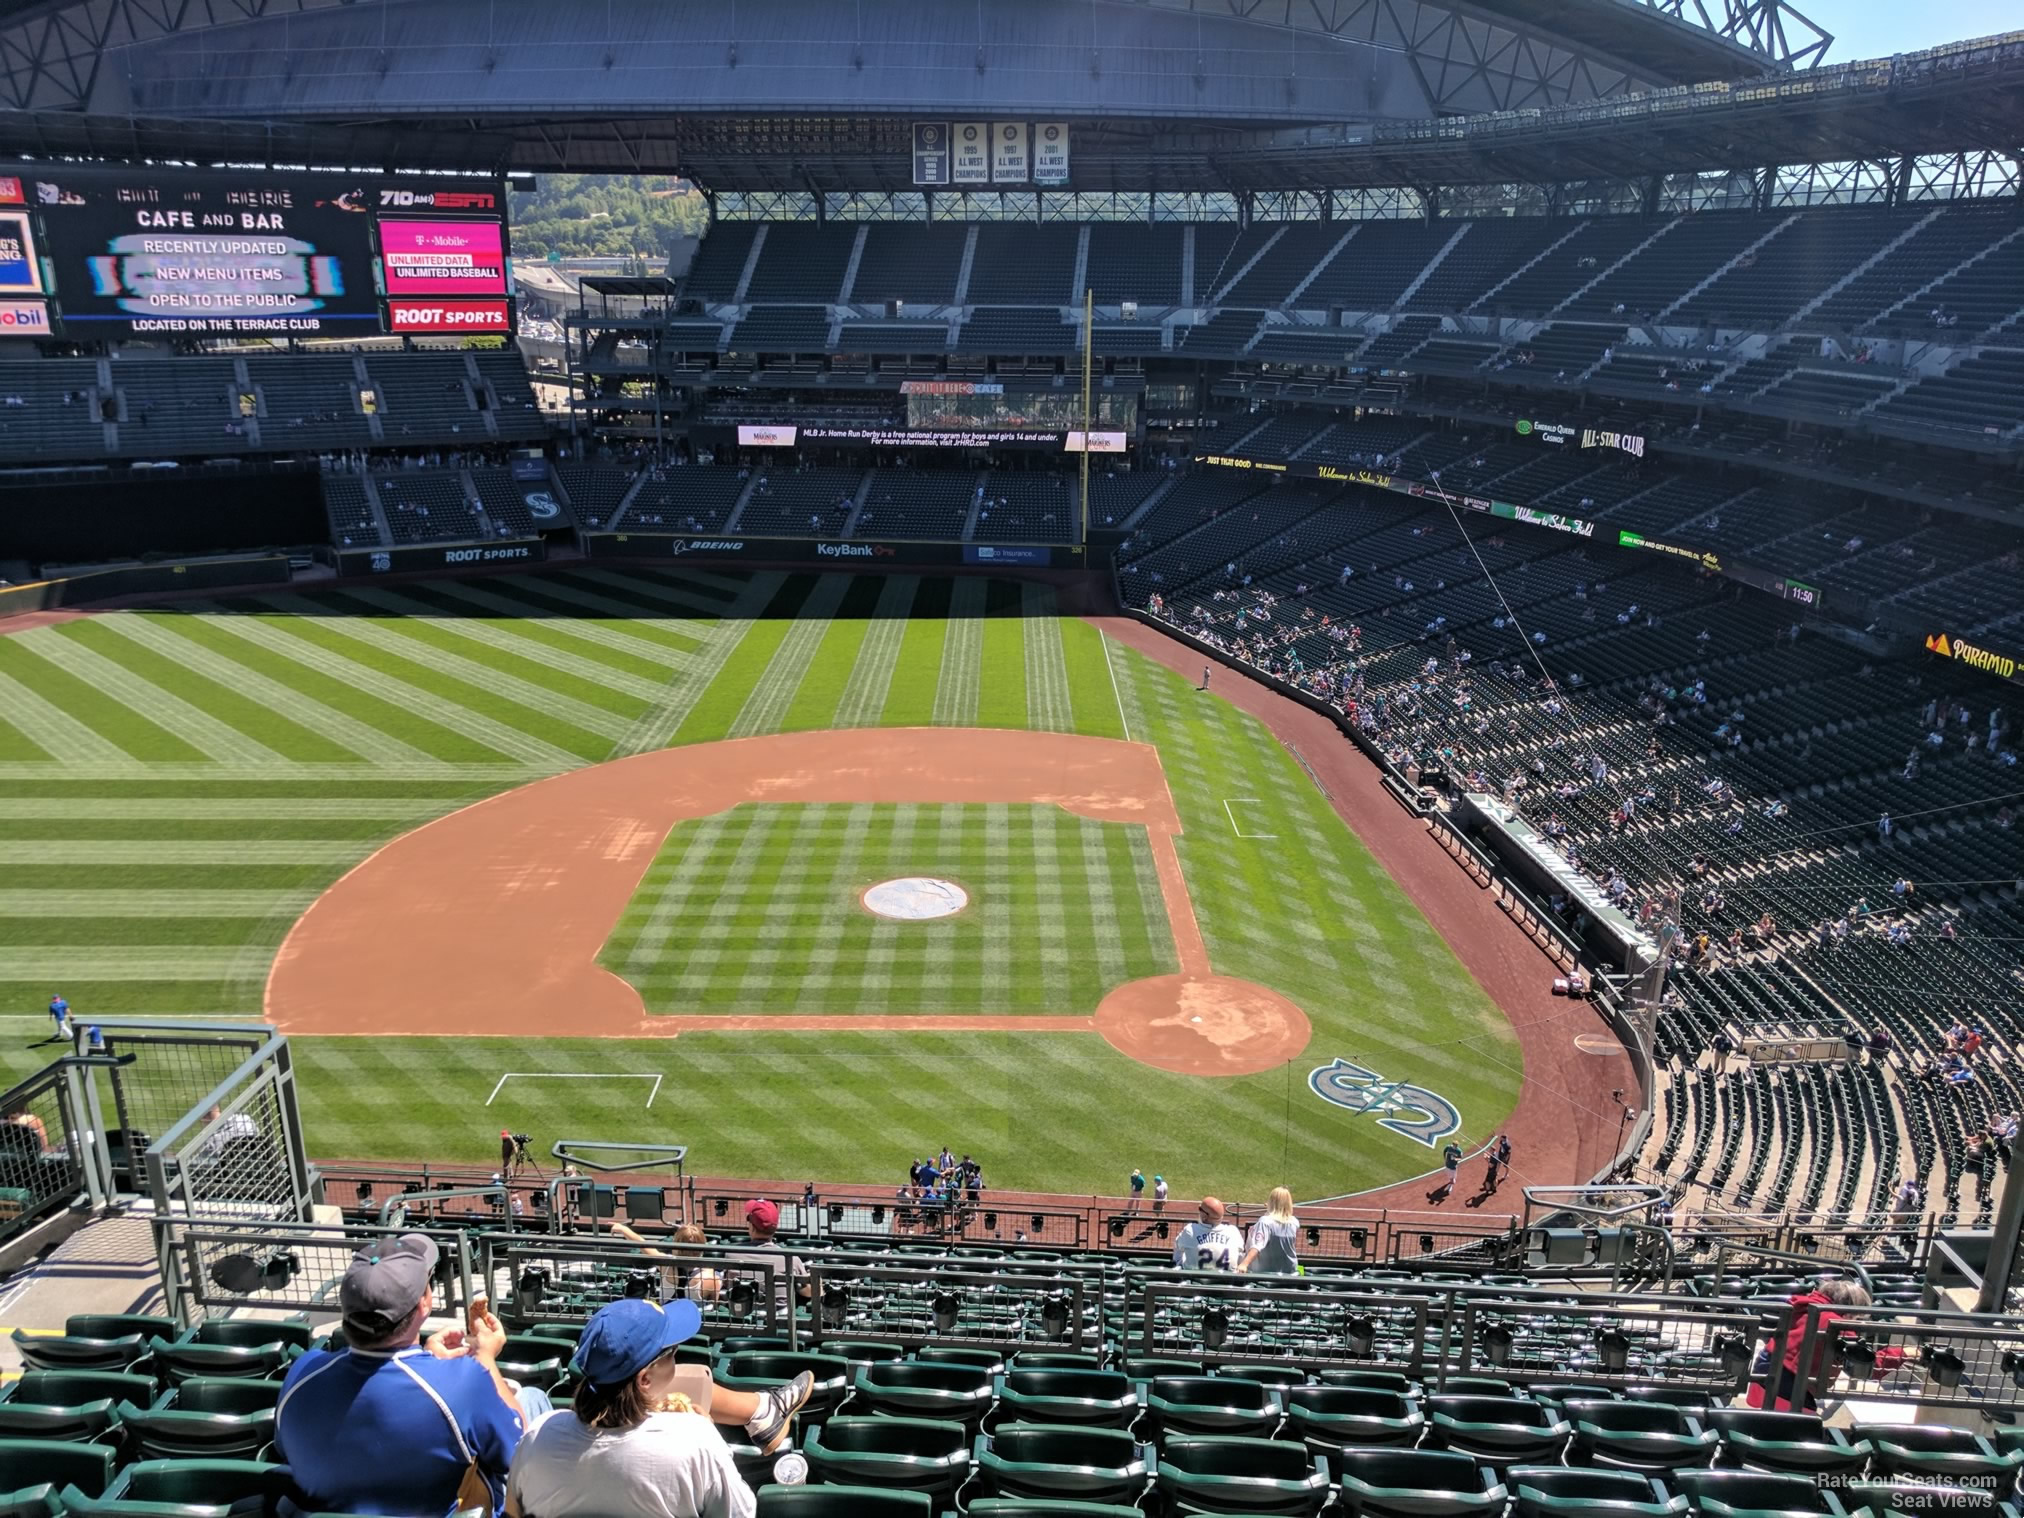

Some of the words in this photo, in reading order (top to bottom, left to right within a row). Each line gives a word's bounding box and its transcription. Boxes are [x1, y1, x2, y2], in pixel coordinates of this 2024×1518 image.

[964, 146, 978, 154] 1995
[1004, 145, 1017, 154] 1997
[1045, 145, 1058, 154] 2001
[968, 157, 983, 167] WEST
[1008, 157, 1024, 166] WEST
[1049, 156, 1064, 166] WEST
[955, 169, 987, 179] CHAMPIONS
[995, 169, 1027, 179] CHAMPIONS
[1036, 168, 1067, 178] CHAMPIONS
[434, 192, 495, 208] ESPN
[137, 210, 195, 227] CAFE
[202, 214, 235, 226] AND
[241, 213, 285, 229] BAR
[144, 240, 217, 254] RECENTLY
[221, 242, 287, 255] UPDATED
[390, 256, 443, 266] UNLIMITED
[445, 257, 470, 266] DATA
[156, 267, 191, 280] NEW
[194, 268, 237, 281] MENU
[240, 268, 283, 281] ITEMS
[396, 268, 449, 278] UNLIMITED
[450, 268, 499, 278] BASEBALL
[149, 294, 190, 307] OPEN
[192, 294, 212, 307] TO
[216, 294, 243, 307] THE
[246, 294, 297, 307] PUBLIC
[395, 309, 443, 324] ROOT
[445, 311, 504, 324] SPORTS
[132, 319, 187, 332] LOCATED
[188, 319, 207, 331] ON
[208, 319, 233, 331] THE
[234, 319, 288, 331] TERRACE
[289, 318, 320, 330] CLUB
[1534, 421, 1556, 433] EMERALD
[803, 429, 818, 437] MLB
[828, 430, 847, 438] Home
[848, 430, 861, 438] Run
[861, 430, 881, 440] Derby
[892, 431, 906, 439] free
[907, 431, 931, 440] national
[932, 433, 960, 442] program
[961, 433, 971, 441] for
[972, 433, 986, 442] boys
[987, 433, 999, 441] and
[1000, 433, 1015, 442] girls
[1016, 433, 1024, 441] 14
[1038, 434, 1058, 442] under.
[1621, 434, 1646, 457] CLUB
[1206, 455, 1220, 466] JUST
[1220, 457, 1234, 467] THAT
[1234, 459, 1252, 469] GOOD
[1318, 466, 1348, 480] Welcome
[1349, 472, 1356, 481] to
[1514, 506, 1541, 525] Welcome
[1541, 512, 1549, 527] to
[1549, 510, 1572, 533] Safeco
[1572, 519, 1595, 537] Field
[690, 542, 744, 550] BOEING
[817, 544, 873, 557] KeyBank
[1622, 536, 1633, 544] JOIN
[1633, 538, 1645, 546] NOW
[1644, 541, 1656, 549] AND
[1655, 543, 1665, 551] GET
[1665, 545, 1678, 554] YOUR
[445, 549, 482, 563] ROOT
[483, 547, 529, 560] SPORTS
[1792, 586, 1813, 603] 11:50
[1953, 639, 2014, 678] PYRAMID
[1196, 1232, 1230, 1246] GRIFFEY
[1198, 1248, 1230, 1271] 24
